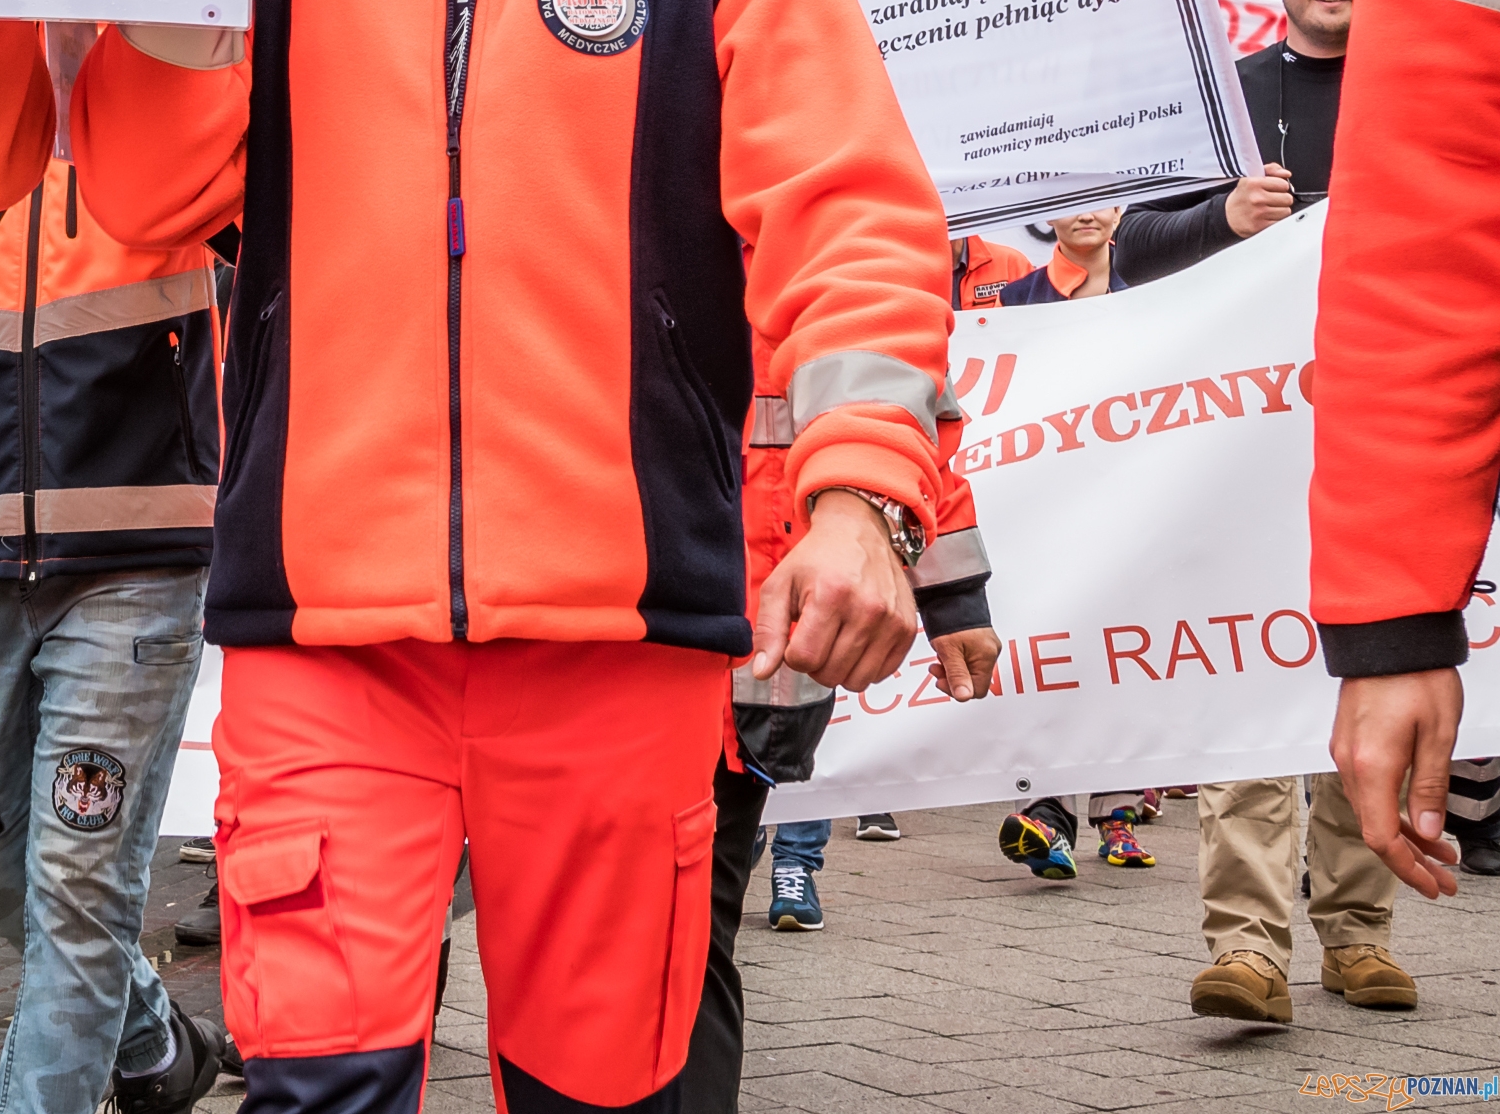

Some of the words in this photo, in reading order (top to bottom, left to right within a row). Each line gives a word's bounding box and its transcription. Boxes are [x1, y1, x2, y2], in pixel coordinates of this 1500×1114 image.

[557, 27, 628, 53] MEDYCZNE
[960, 113, 1055, 145] zawiadamiają
[963, 136, 1032, 161] ratownicy
[1034, 120, 1100, 146] medyczni
[1102, 108, 1136, 131] całej
[1138, 102, 1184, 123] Polski
[990, 176, 1012, 188] ZA
[93, 753, 120, 775] WOLF
[60, 805, 75, 820] NO
